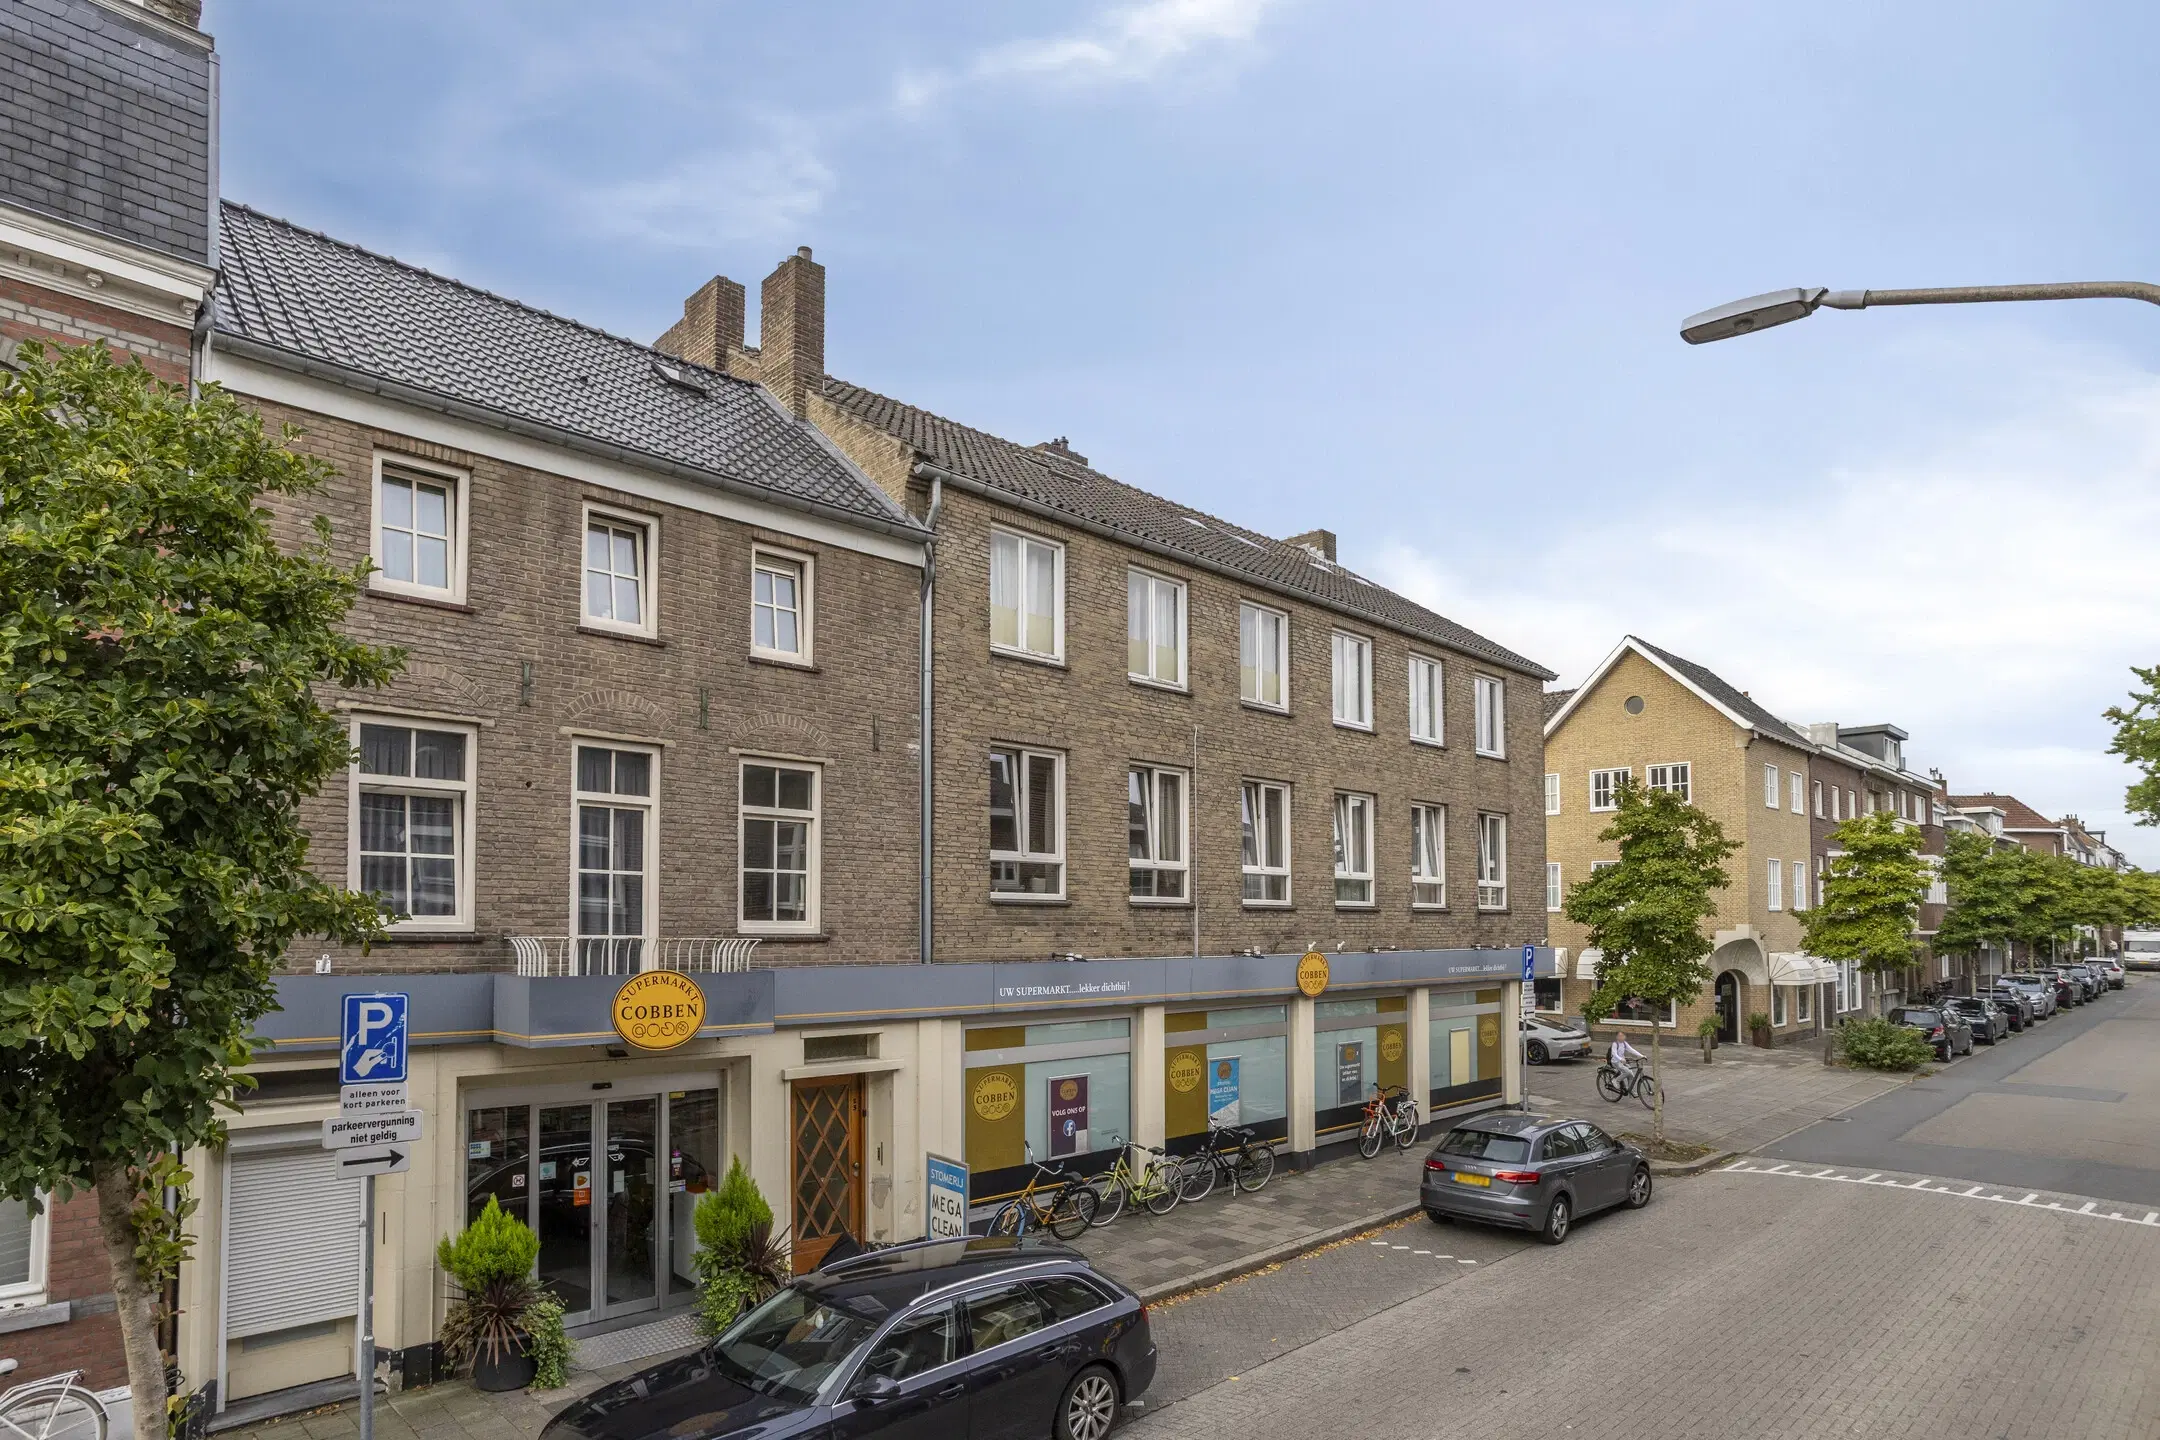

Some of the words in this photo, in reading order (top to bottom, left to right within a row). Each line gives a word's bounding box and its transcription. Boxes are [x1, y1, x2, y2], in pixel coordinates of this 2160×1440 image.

[1526, 948, 1532, 966] P
[1300, 970, 1327, 979] COBBEN
[621, 975, 700, 1003] SUPERMARKT
[999, 987, 1015, 997] UW
[621, 1003, 699, 1020] COBBEN
[358, 1001, 394, 1046] P
[1171, 1068, 1200, 1079] COBBEN
[976, 1075, 1016, 1093] SUPERMARKT
[349, 1089, 378, 1099] alleen
[381, 1088, 401, 1096] voor
[976, 1091, 1015, 1105] COBBEN
[343, 1101, 362, 1110] kort
[365, 1098, 406, 1109] parkeren
[1052, 1109, 1066, 1117] VOLG
[1067, 1106, 1078, 1115] ONS
[331, 1115, 415, 1134] parkeervergunning
[350, 1133, 368, 1144] niet
[370, 1130, 397, 1144] geldig
[930, 1168, 965, 1189] STOMERIJ
[931, 1193, 962, 1219] MEGA
[931, 1216, 962, 1238] CLEAN
